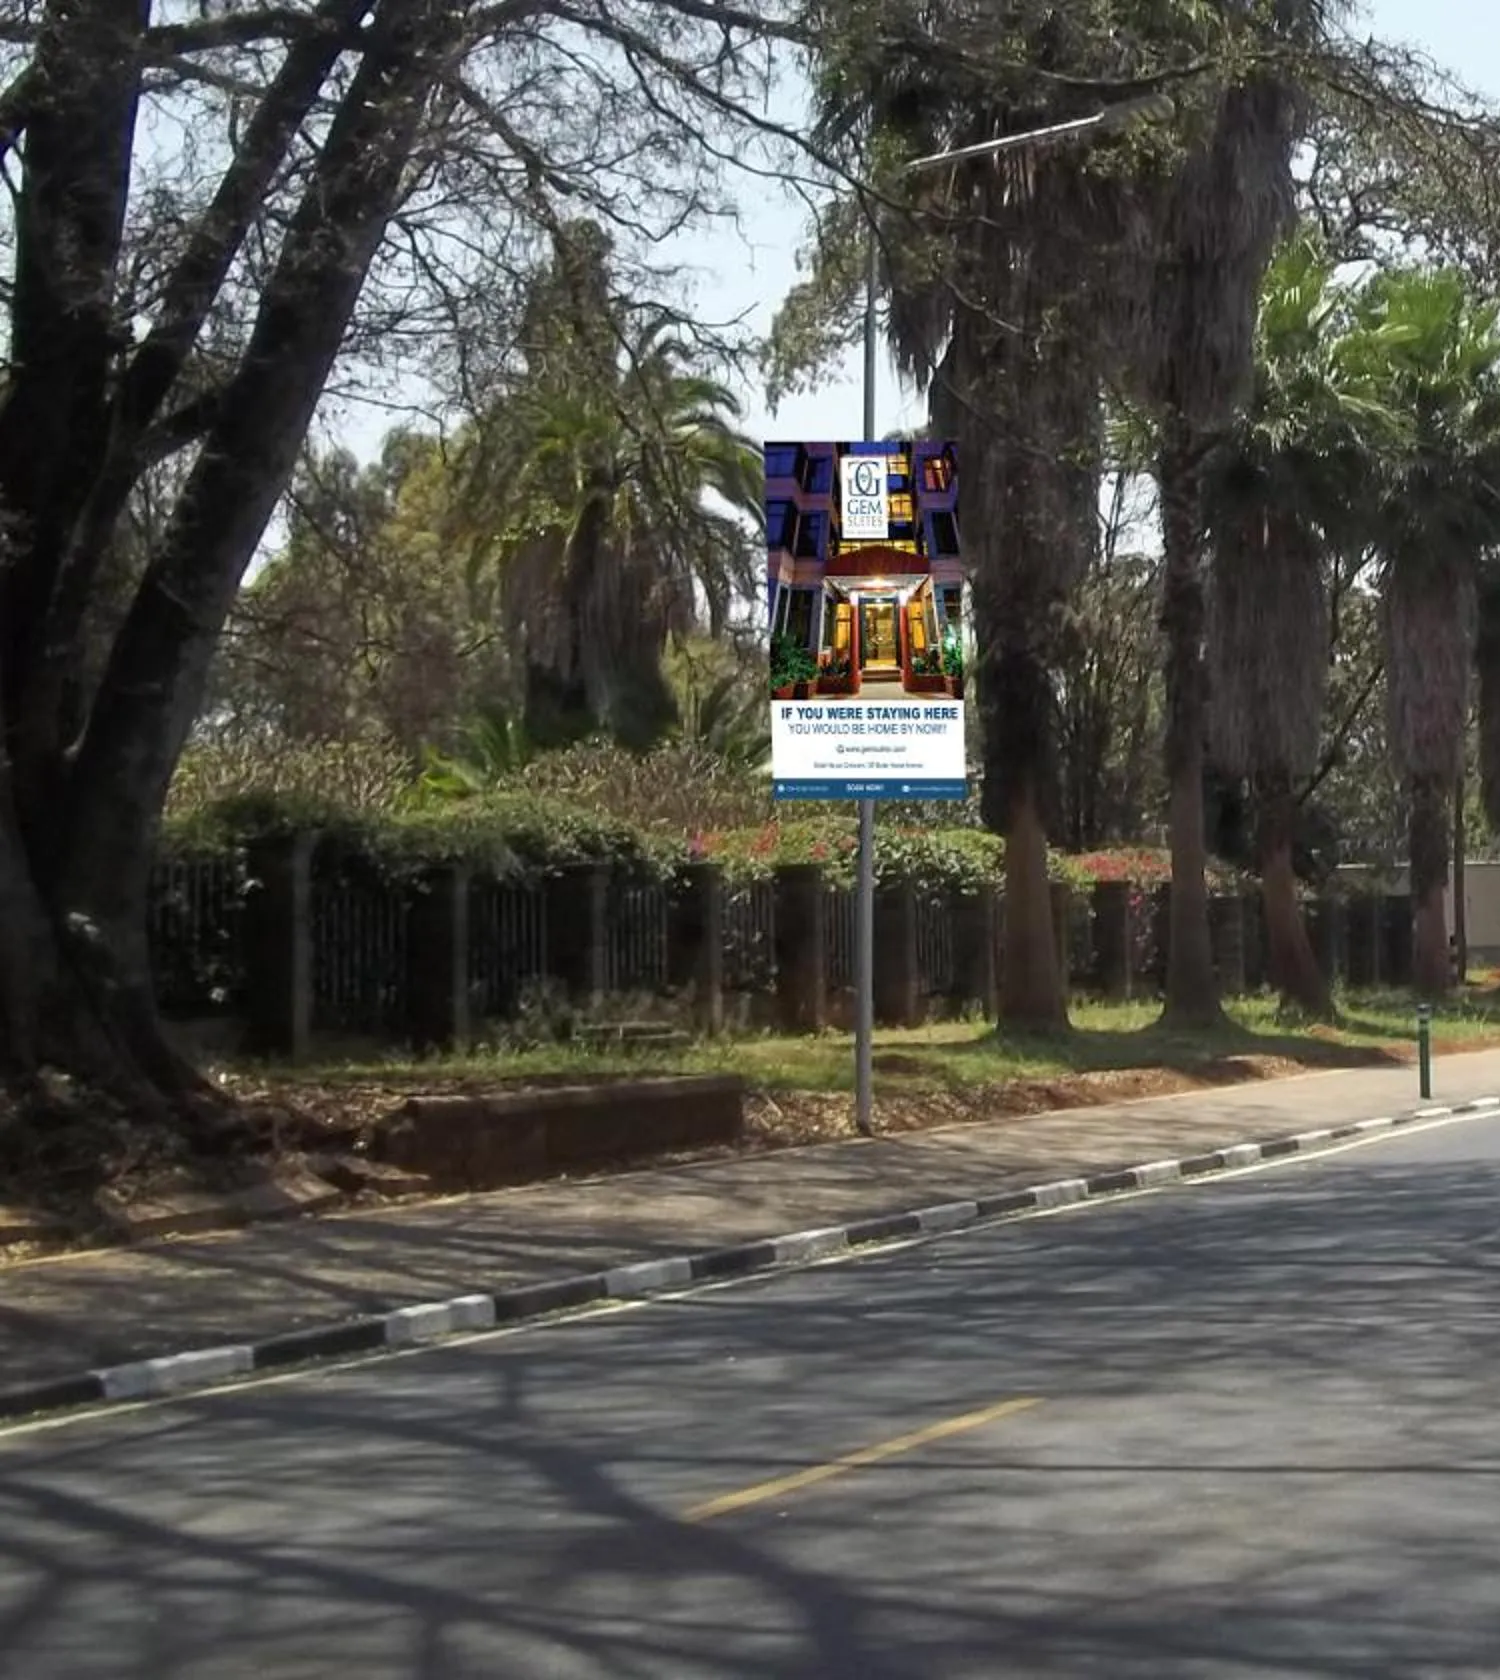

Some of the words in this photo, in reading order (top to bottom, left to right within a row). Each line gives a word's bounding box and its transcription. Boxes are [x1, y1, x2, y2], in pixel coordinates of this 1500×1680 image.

[847, 499, 883, 515] GEM
[847, 515, 883, 528] SUITES
[781, 707, 793, 720] IF
[796, 707, 823, 720] YOU
[826, 707, 863, 720] WERE
[867, 707, 920, 720] STAYING
[923, 707, 959, 720] HERE
[788, 723, 811, 735] YOU
[812, 723, 851, 735] WOULD
[851, 723, 866, 735] BE
[867, 723, 898, 735] HOME
[900, 723, 914, 735] BY
